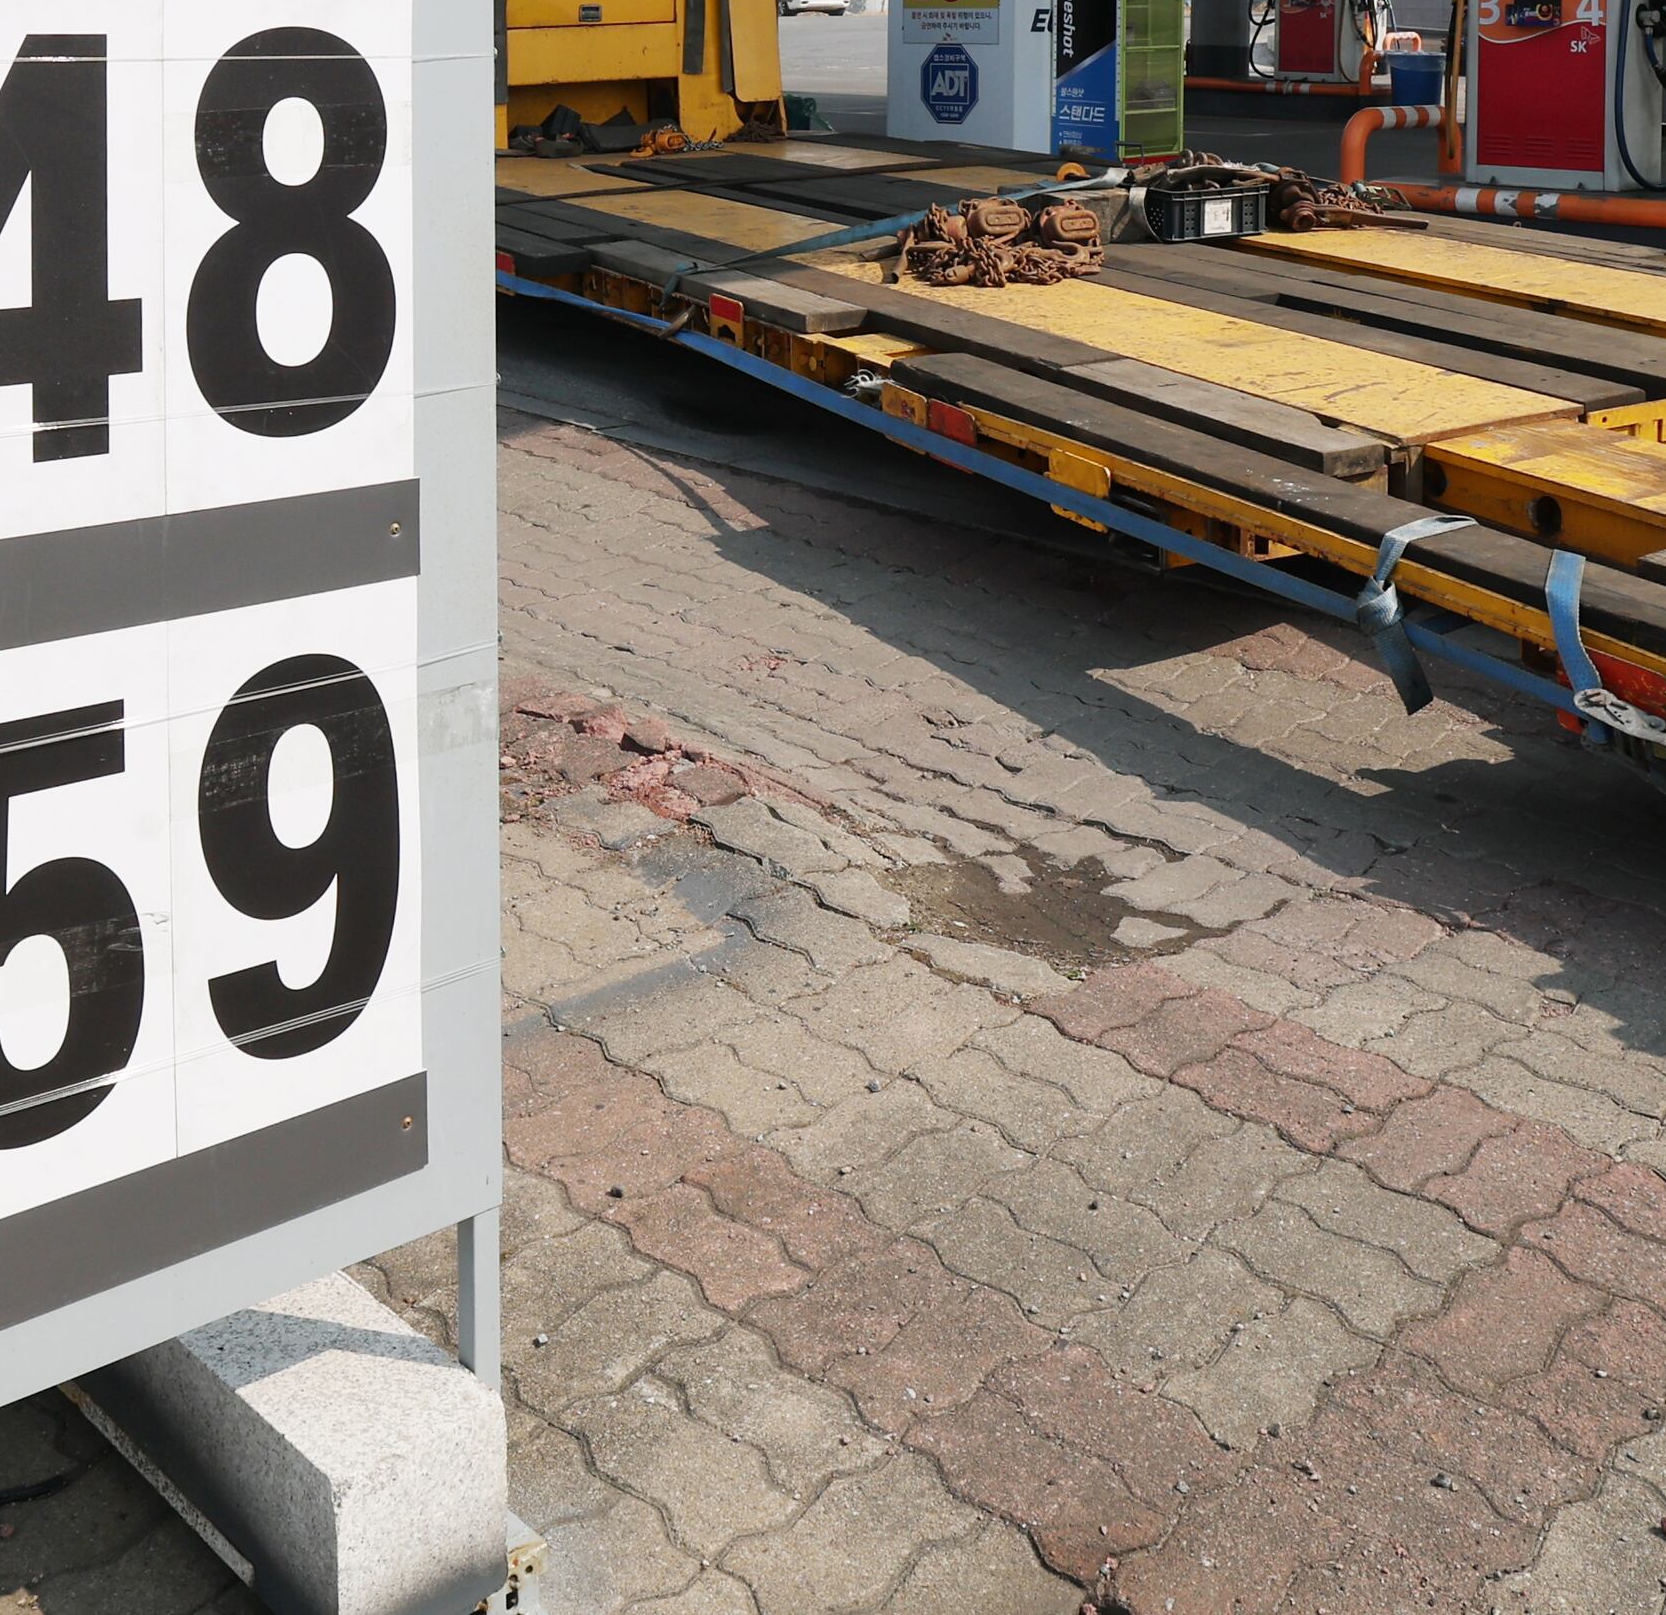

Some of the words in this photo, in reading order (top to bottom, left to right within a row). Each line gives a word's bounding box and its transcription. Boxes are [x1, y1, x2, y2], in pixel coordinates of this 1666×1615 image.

[1570, 40, 1588, 53] SK
[930, 70, 969, 97] ADT
[1059, 105, 1106, 122] 스탠다드
